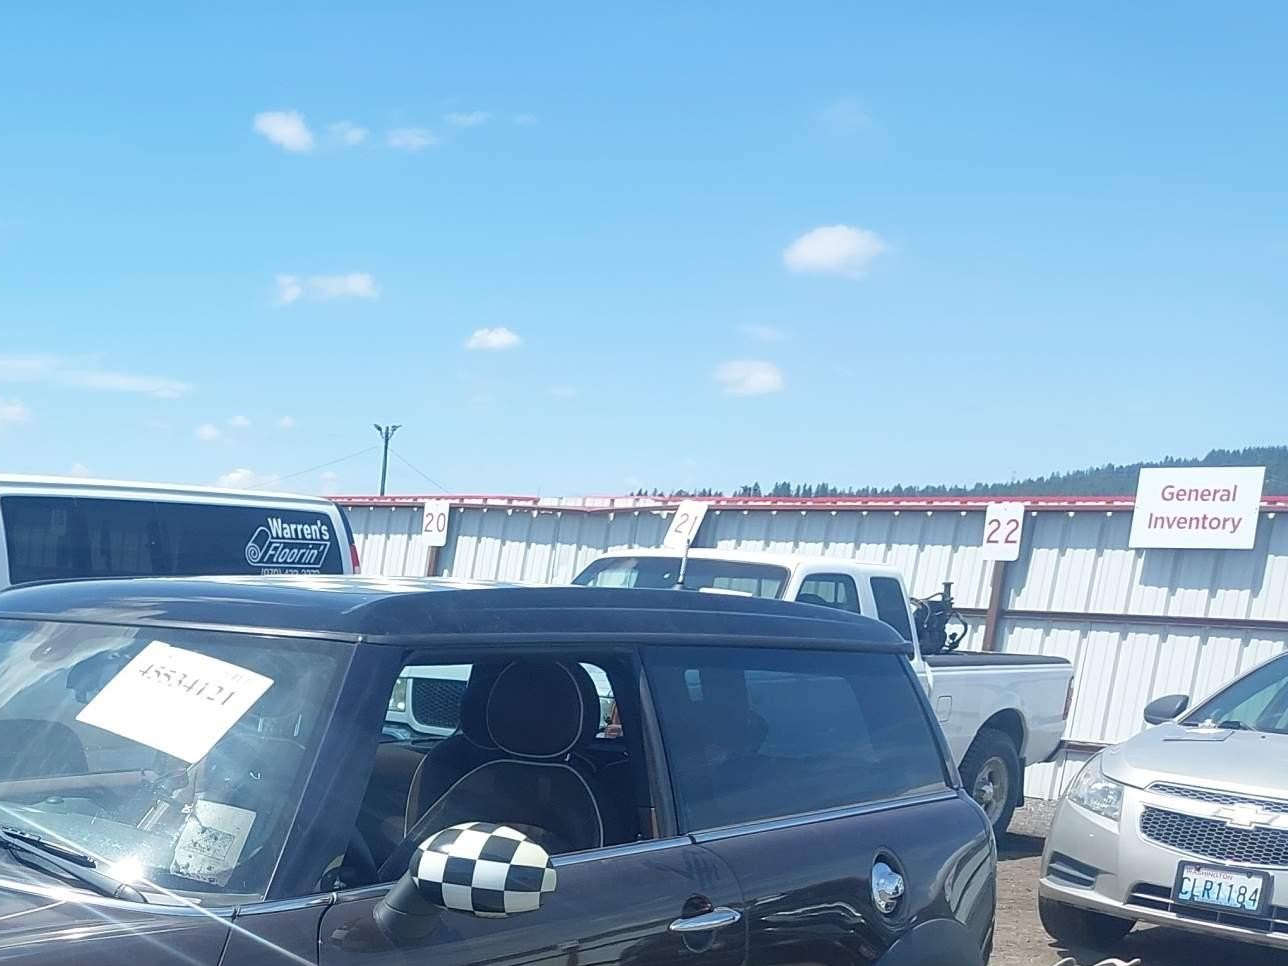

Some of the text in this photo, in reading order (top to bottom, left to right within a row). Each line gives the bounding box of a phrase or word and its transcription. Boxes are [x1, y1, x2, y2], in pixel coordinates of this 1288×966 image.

[1160, 484, 1238, 503] General
[267, 517, 330, 540] Warren's
[423, 512, 447, 533] 20
[674, 513, 699, 536] 21
[985, 518, 1020, 544] 22
[1147, 512, 1243, 535] Inventory
[263, 542, 325, 564] Floorin'
[138, 663, 236, 706] 45534121
[1179, 876, 1259, 908] CLR1184
